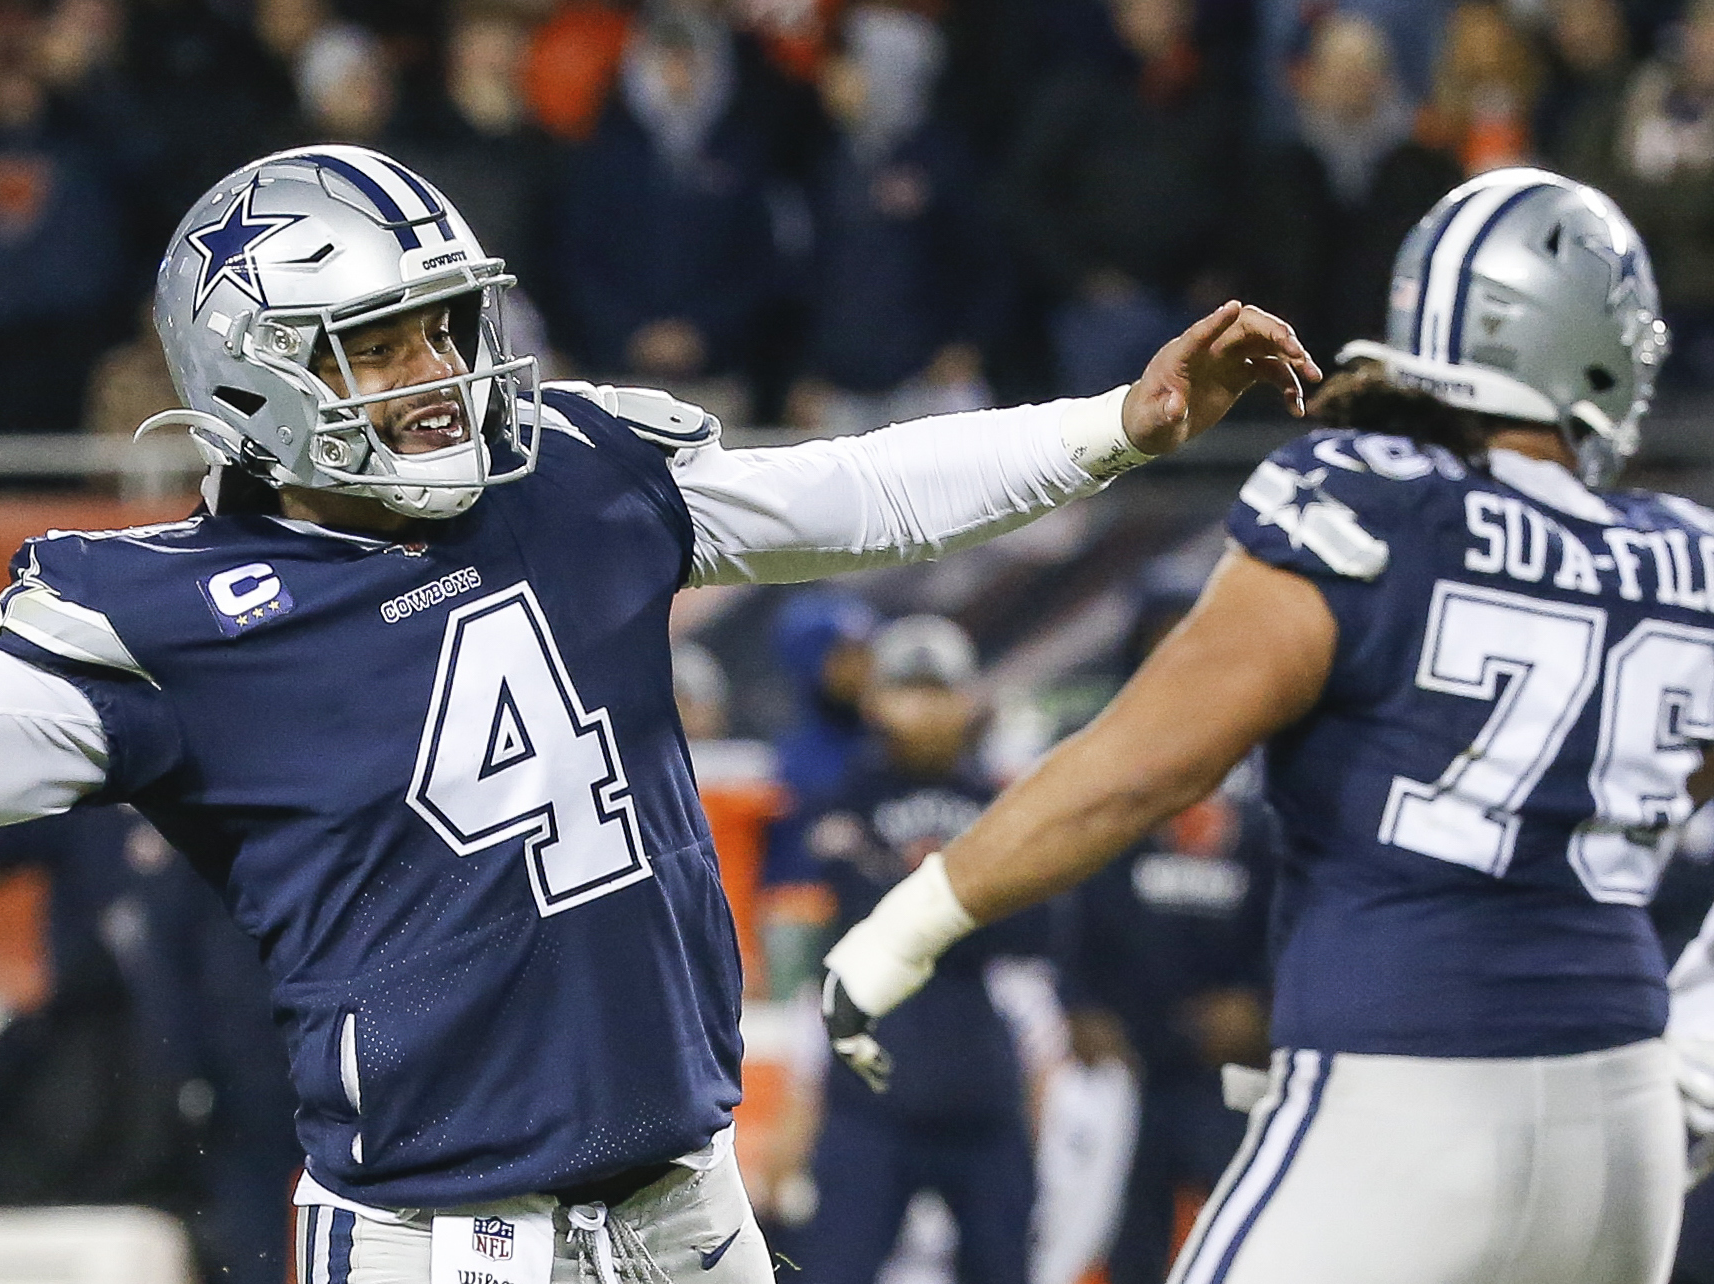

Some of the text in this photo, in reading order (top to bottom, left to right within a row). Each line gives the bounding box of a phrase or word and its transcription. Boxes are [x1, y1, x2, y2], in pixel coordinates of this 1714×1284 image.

[208, 562, 282, 616] C
[380, 566, 482, 623] COWBOYS
[405, 579, 654, 918] 4
[475, 1233, 510, 1258] NFL
